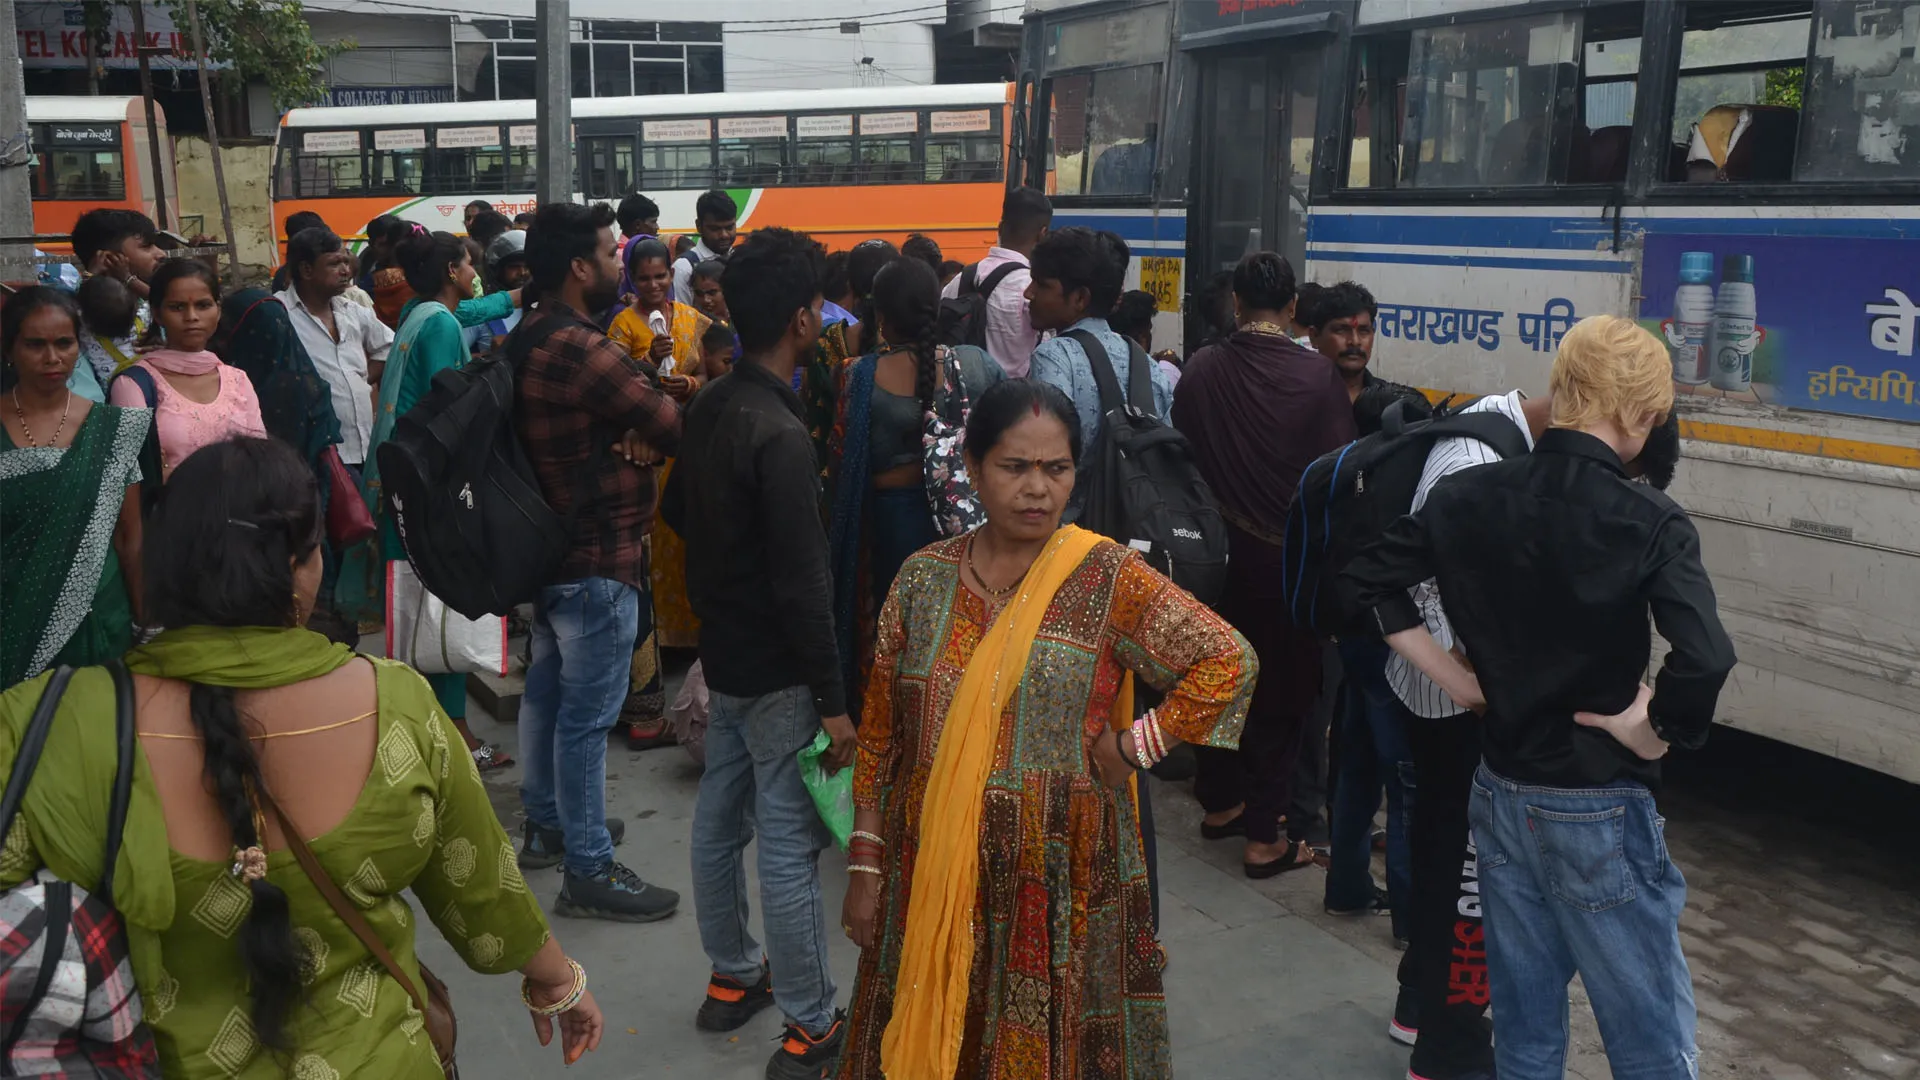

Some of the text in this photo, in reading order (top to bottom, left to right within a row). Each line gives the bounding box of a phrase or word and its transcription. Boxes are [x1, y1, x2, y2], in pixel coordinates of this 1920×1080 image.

[338, 90, 387, 106] COLLEGE
[391, 90, 405, 105] OF
[1373, 303, 1504, 351] त्तराखण्ड
[1807, 365, 1920, 405] इन्सिपि
[1172, 528, 1202, 540] eebok
